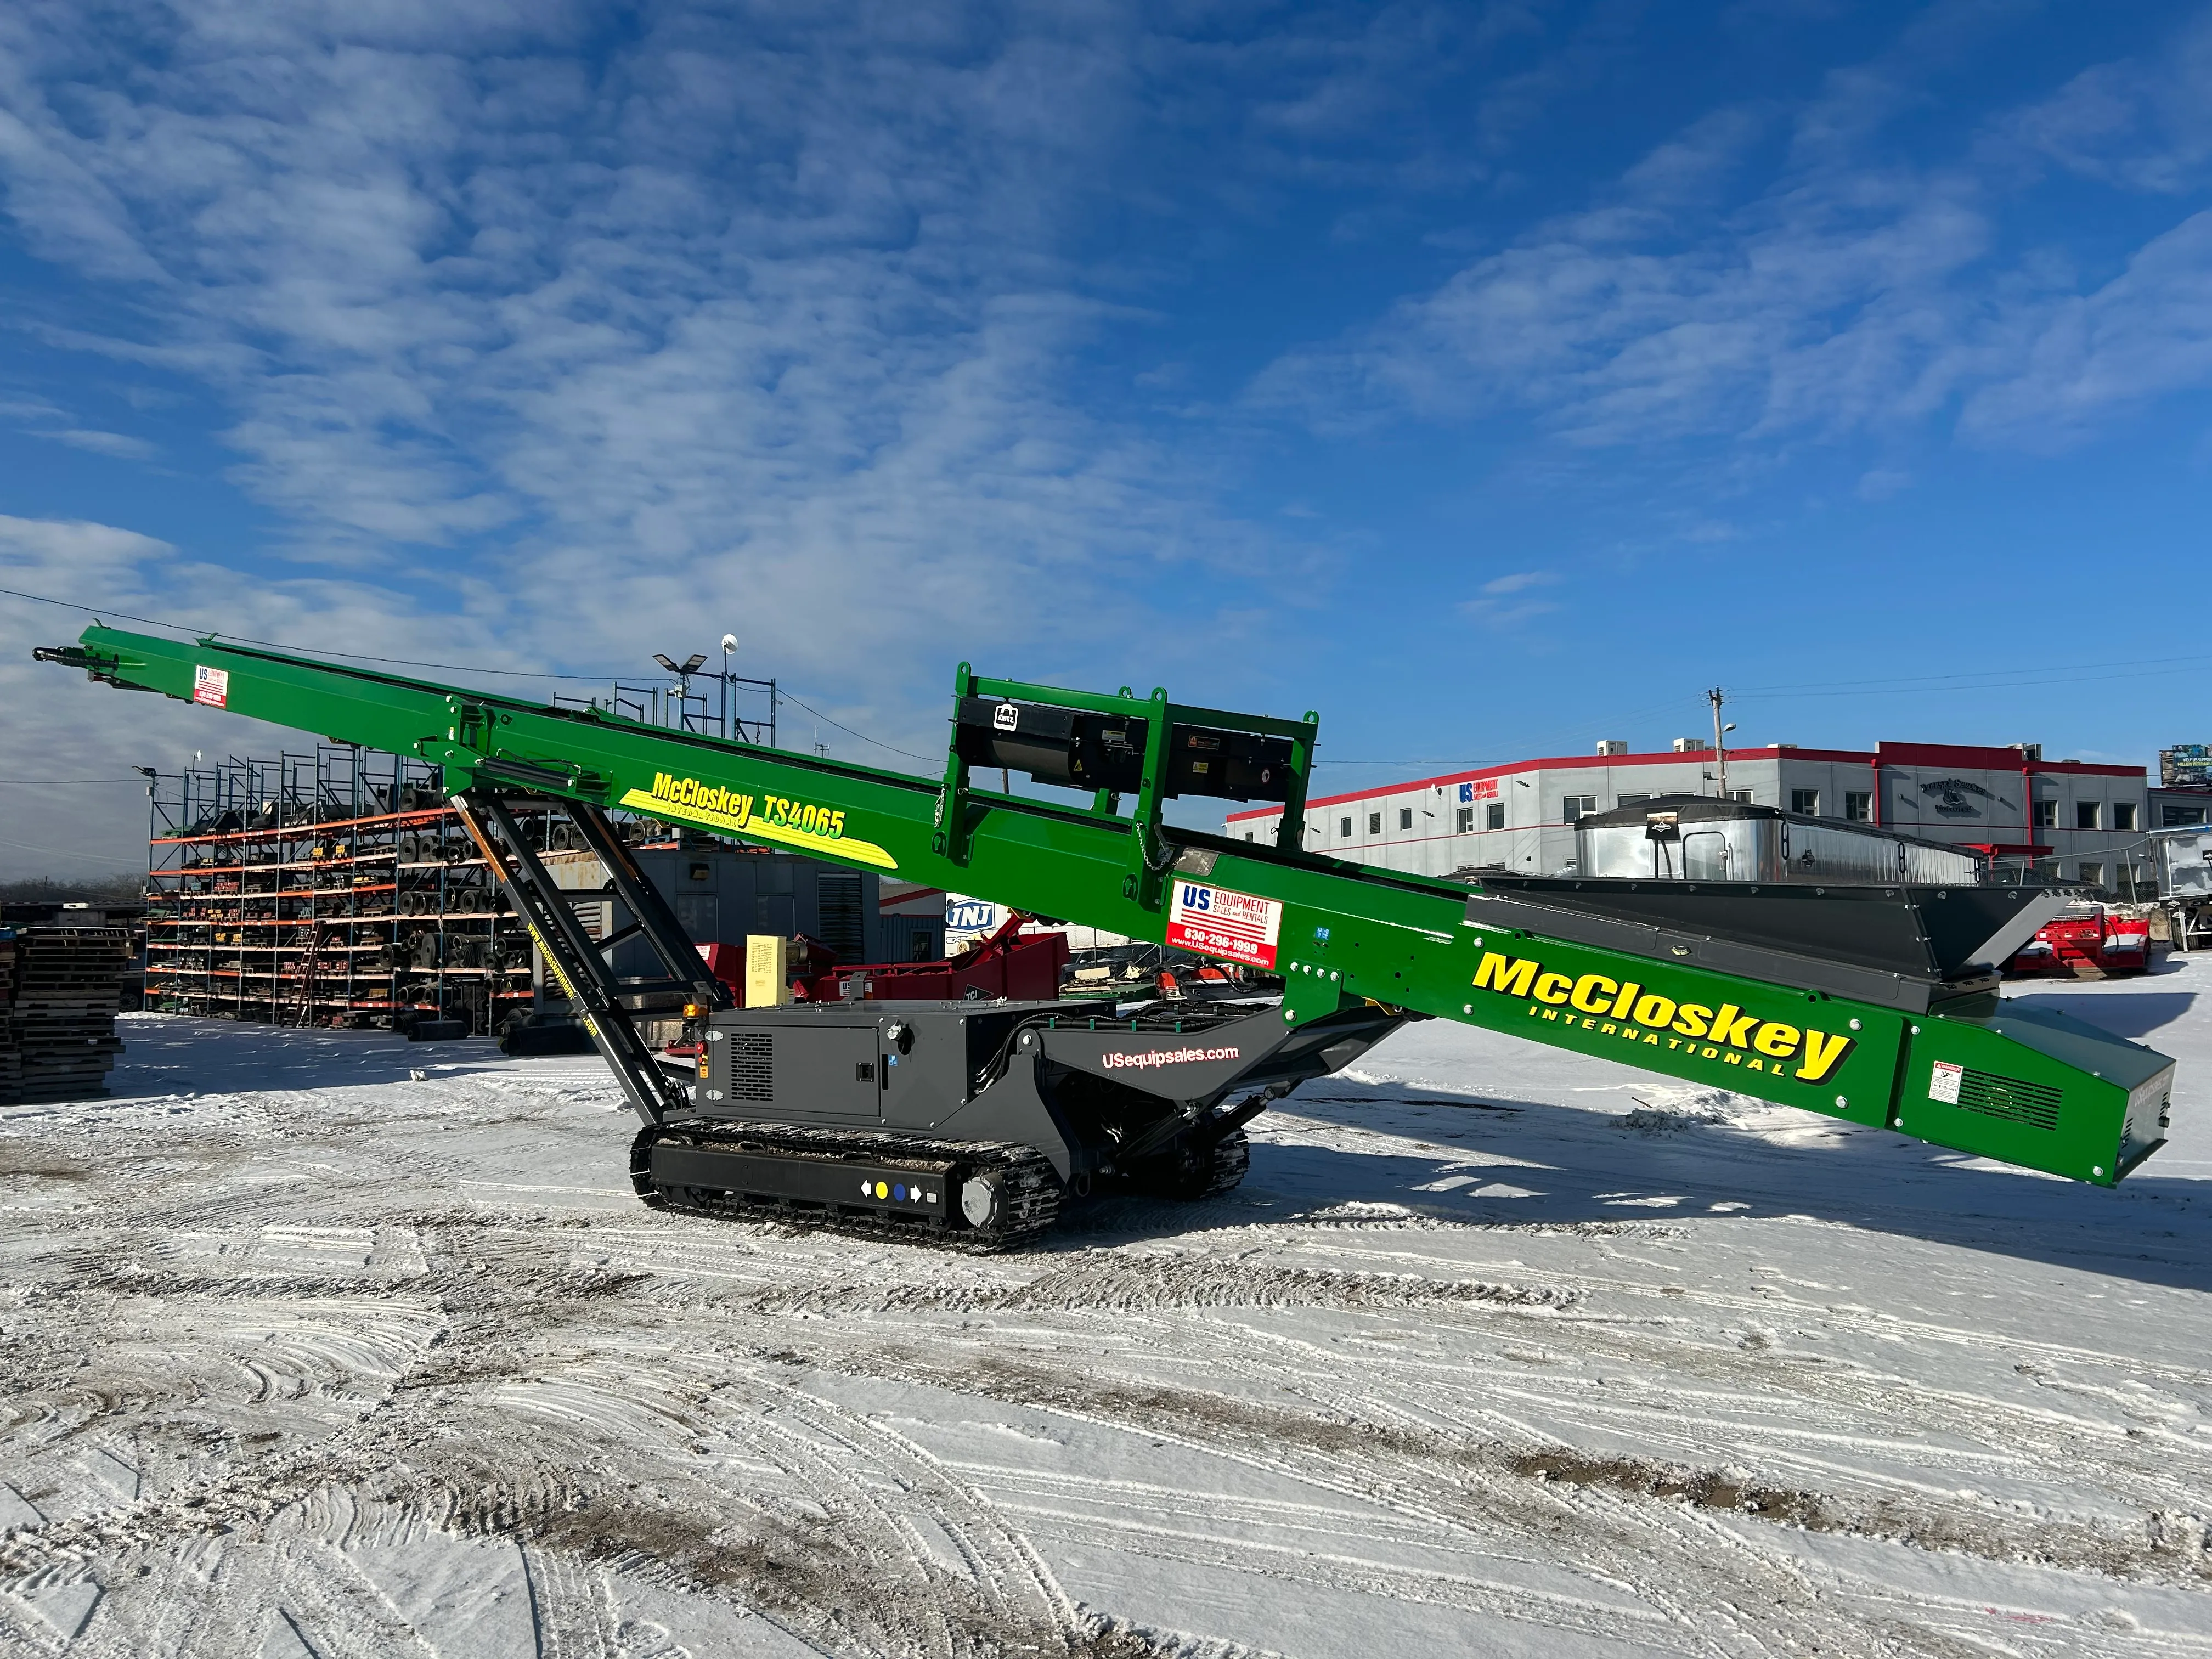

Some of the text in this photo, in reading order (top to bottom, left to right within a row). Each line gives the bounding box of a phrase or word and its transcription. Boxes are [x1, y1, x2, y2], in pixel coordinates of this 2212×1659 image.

[652, 772, 754, 828] McCloskey
[667, 804, 737, 827] INTERNATIONAL
[763, 795, 845, 839] TS4065
[1212, 905, 1232, 916] SALES
[1242, 911, 1268, 924] RENTALS
[1214, 891, 1271, 915] EQUIPMENT
[949, 906, 991, 927] JNJ
[1171, 936, 1269, 967] www.USequipsales.com
[966, 989, 978, 1001] TCI
[1472, 951, 1853, 1082] McCloskey
[1528, 1006, 1785, 1077] INTERNATIONAL
[1102, 1047, 1239, 1069] USequipsales.com
